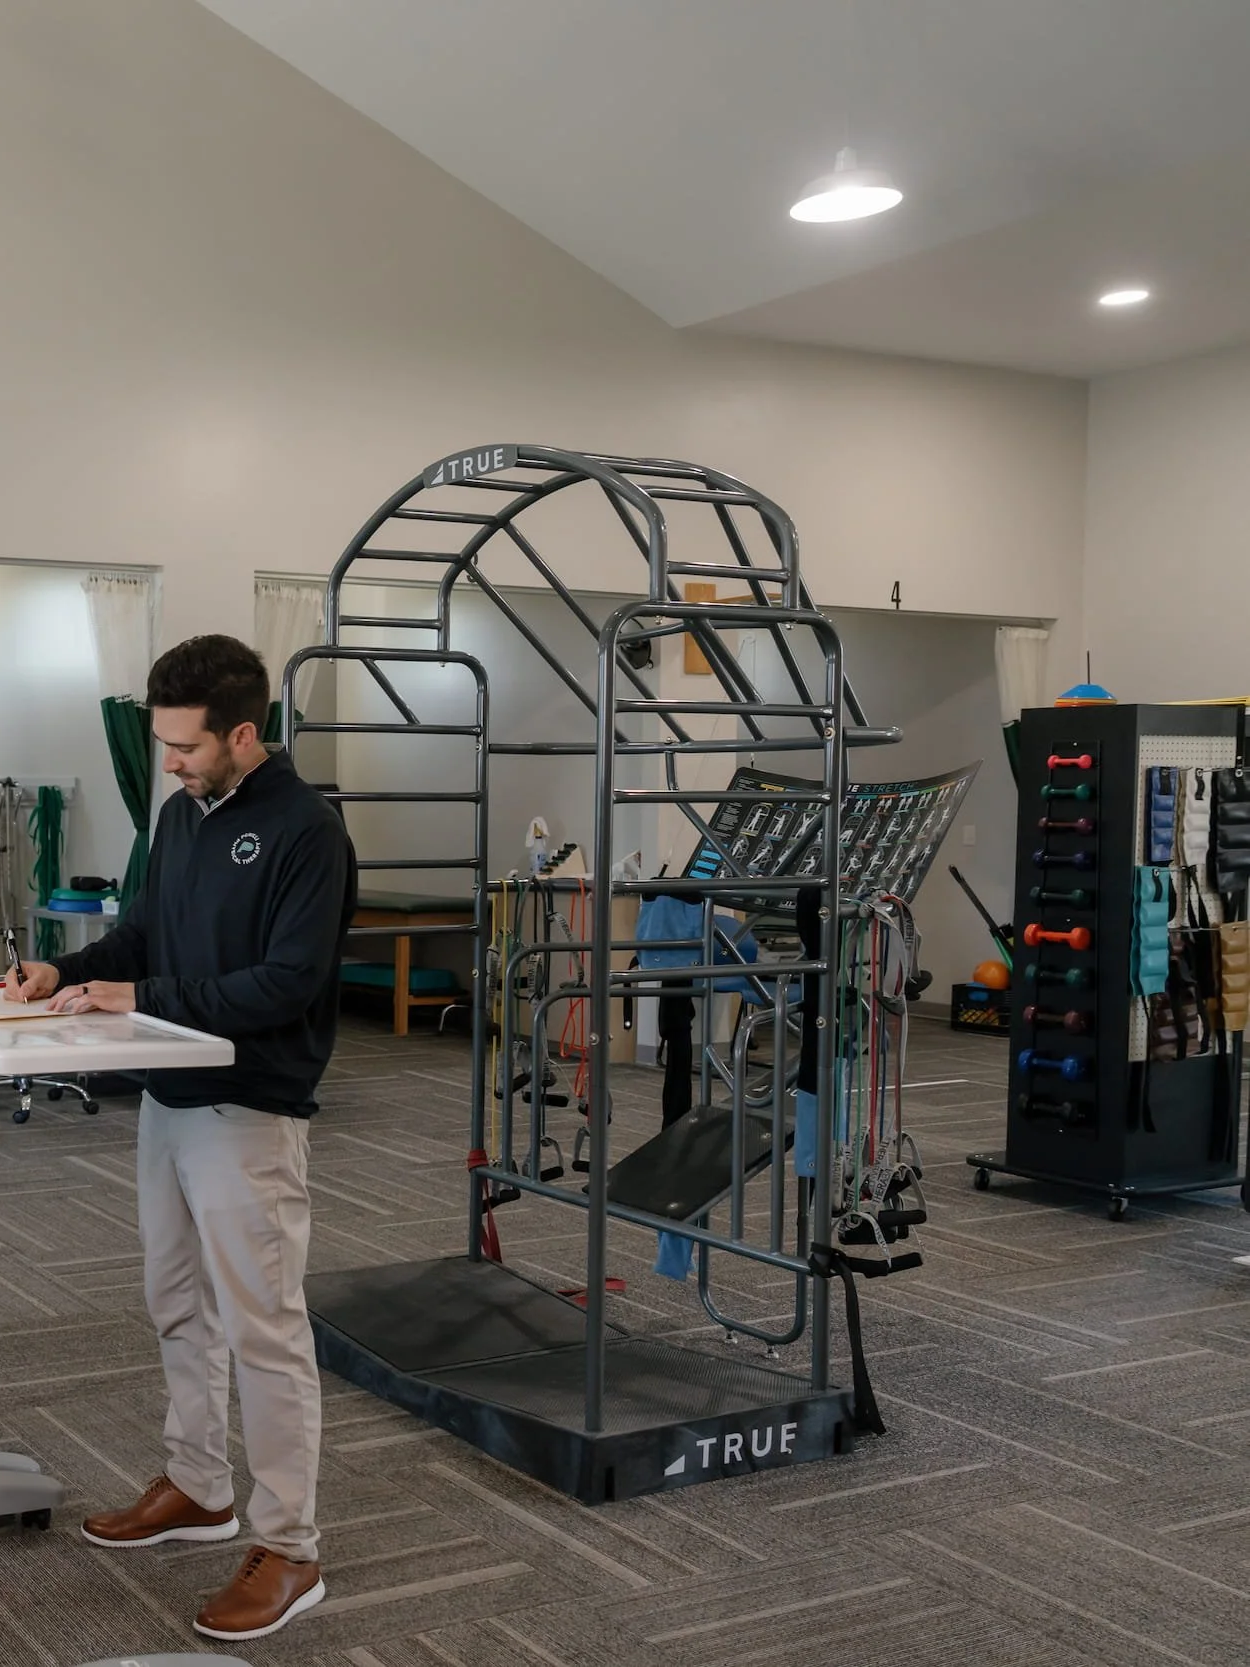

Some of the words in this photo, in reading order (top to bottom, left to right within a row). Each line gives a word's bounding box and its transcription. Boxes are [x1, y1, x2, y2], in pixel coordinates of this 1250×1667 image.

[448, 448, 505, 480] TRUE
[891, 580, 902, 610] 4
[862, 783, 915, 793] STRETCH
[696, 1422, 798, 1469] TRUE
